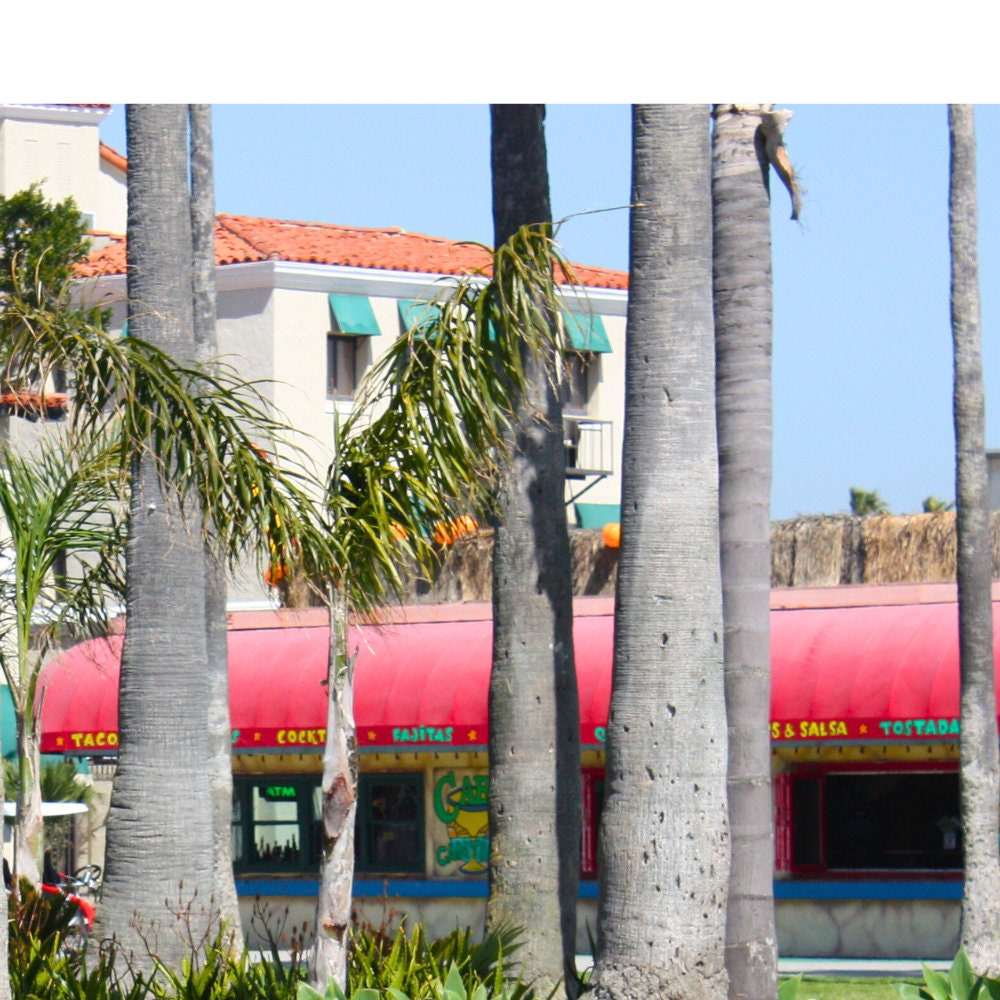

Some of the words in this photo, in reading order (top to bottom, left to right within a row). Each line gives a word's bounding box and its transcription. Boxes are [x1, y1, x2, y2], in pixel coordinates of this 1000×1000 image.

[392, 724, 454, 742] FAJITAS
[784, 723, 795, 738] &
[800, 721, 848, 738] SALSA
[879, 718, 960, 736] TOSTADA
[71, 732, 118, 747] TACO
[276, 729, 327, 745] COCKT
[266, 786, 297, 797] ATM
